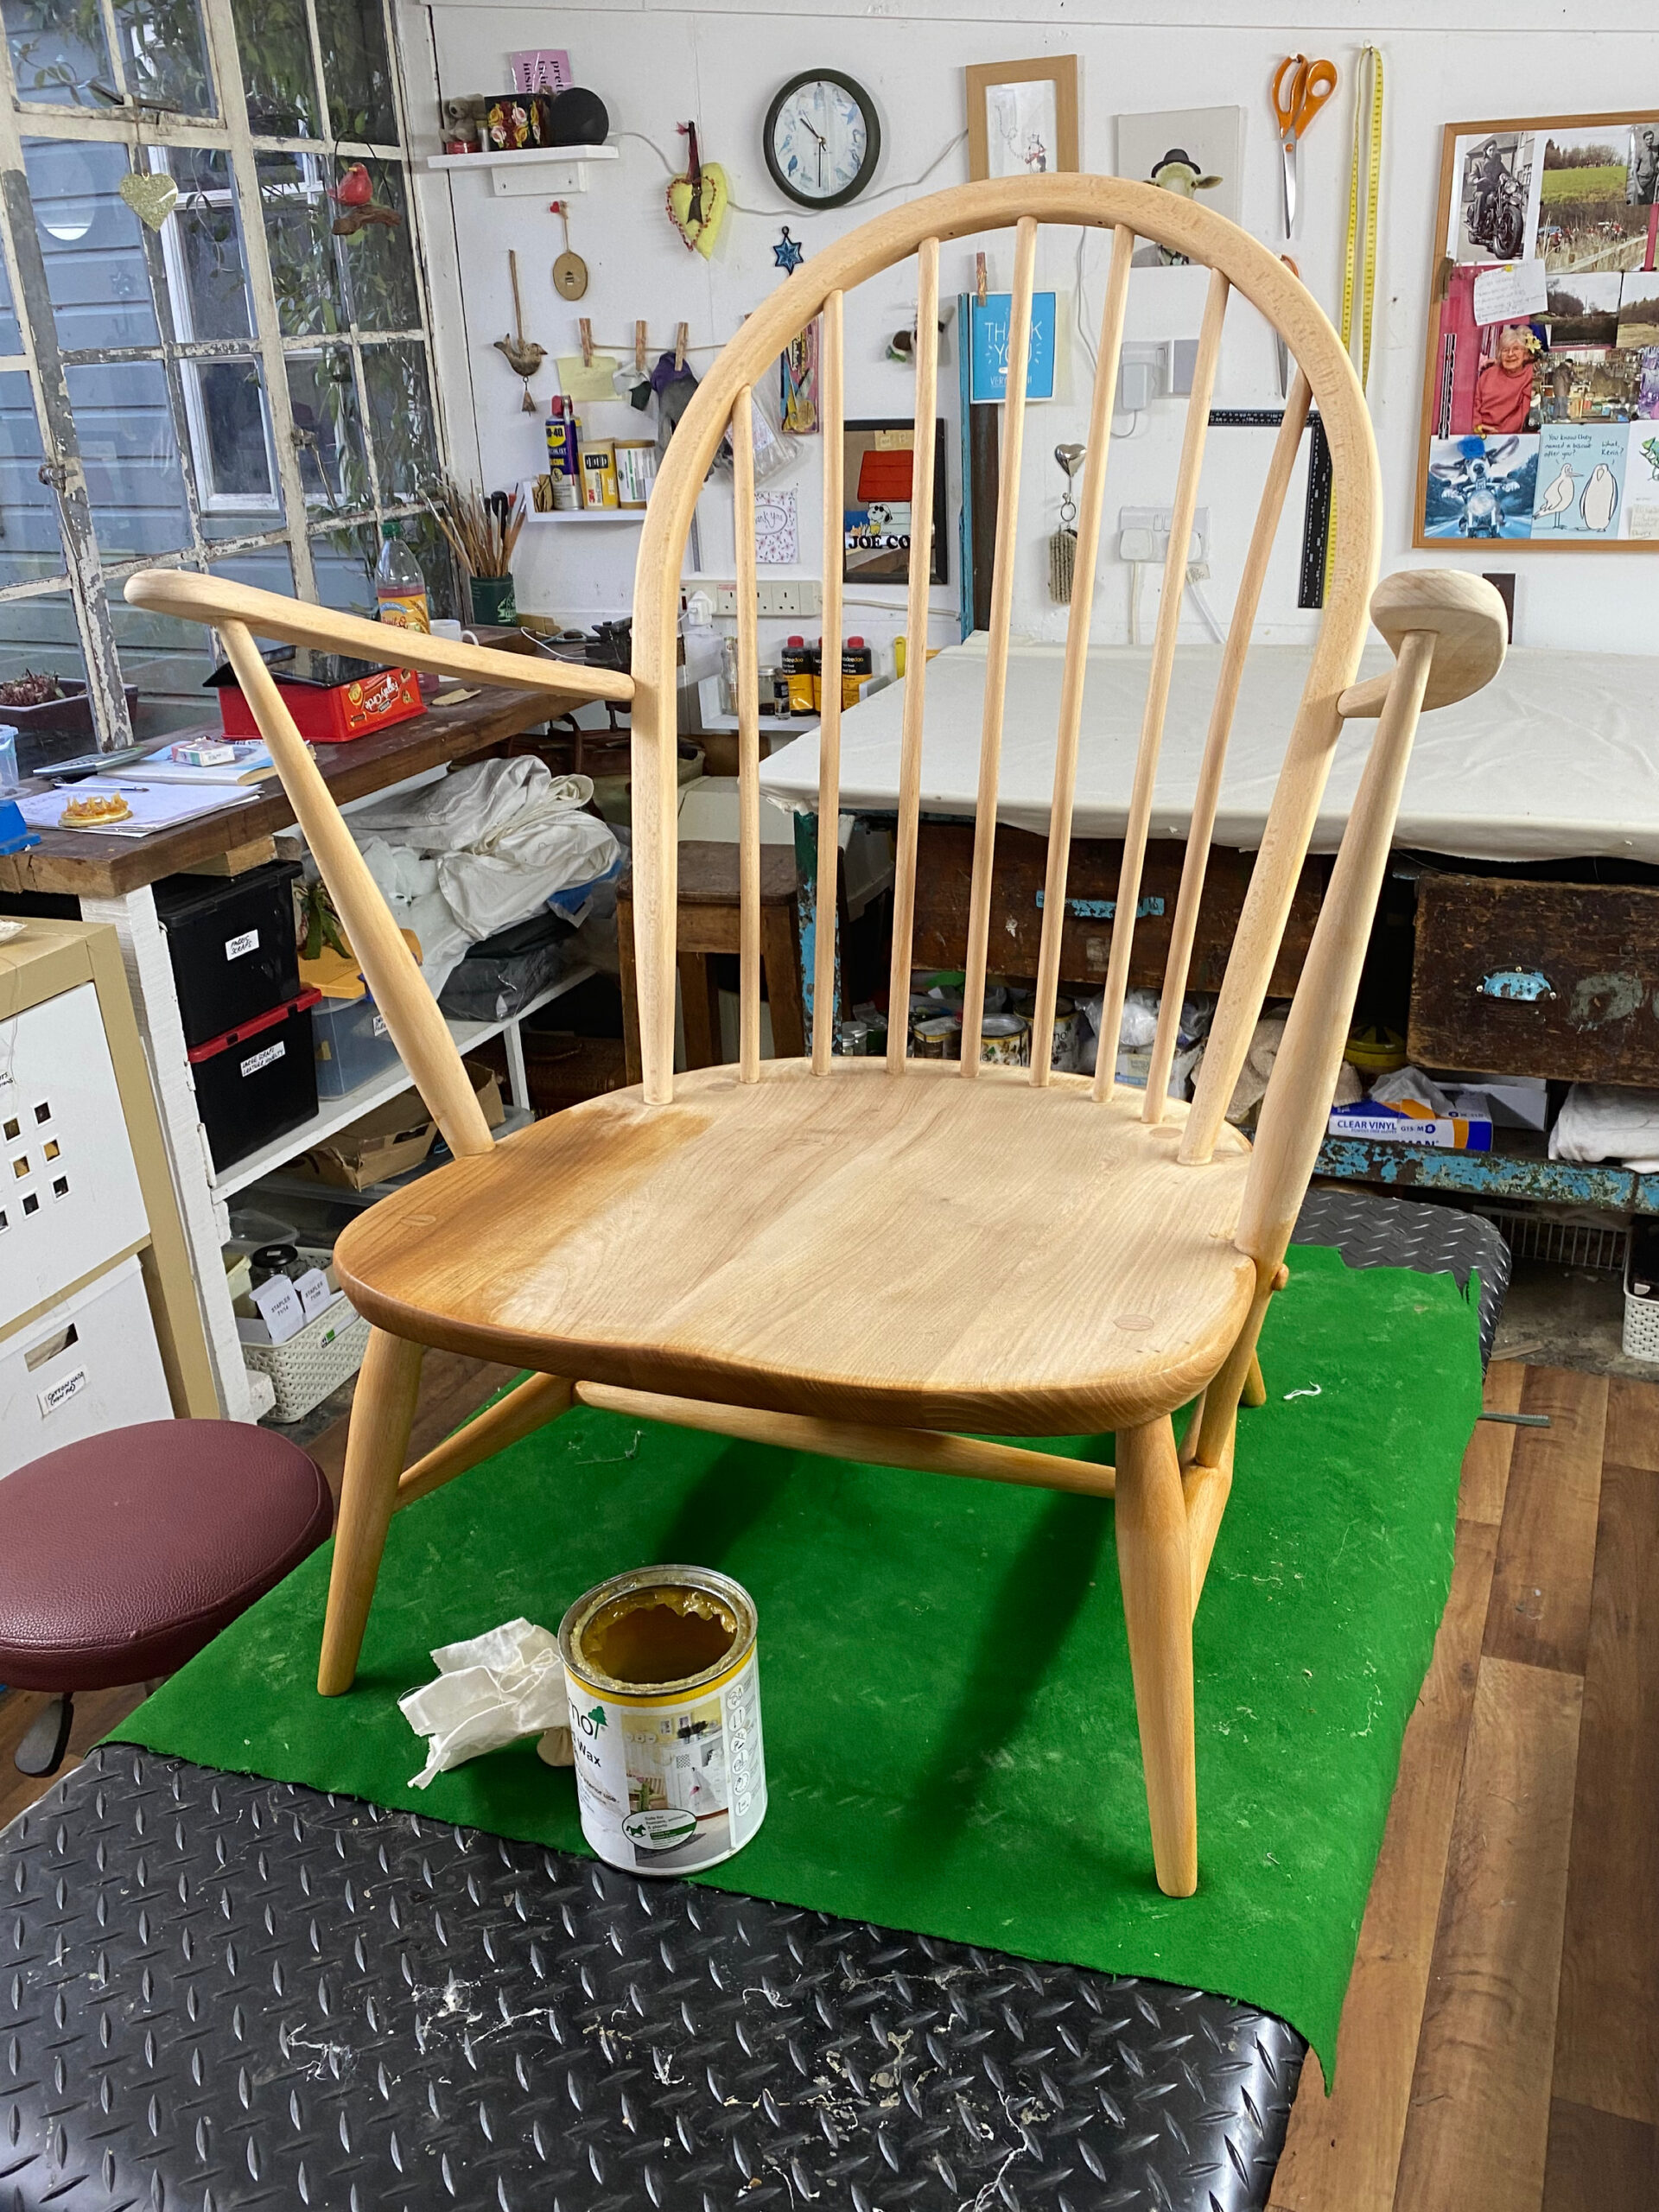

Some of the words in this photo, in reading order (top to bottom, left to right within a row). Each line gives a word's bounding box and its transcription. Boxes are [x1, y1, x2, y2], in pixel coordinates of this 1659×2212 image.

[985, 321, 1042, 342] THK
[849, 535, 883, 550] JOE
[887, 535, 911, 550] CO
[1338, 1120, 1369, 1129] CLEAR
[1370, 1122, 1397, 1131] VINYL
[305, 1281, 323, 1298] STAPLES
[270, 1295, 290, 1313] STAPLES
[577, 1737, 601, 1768] Wax
